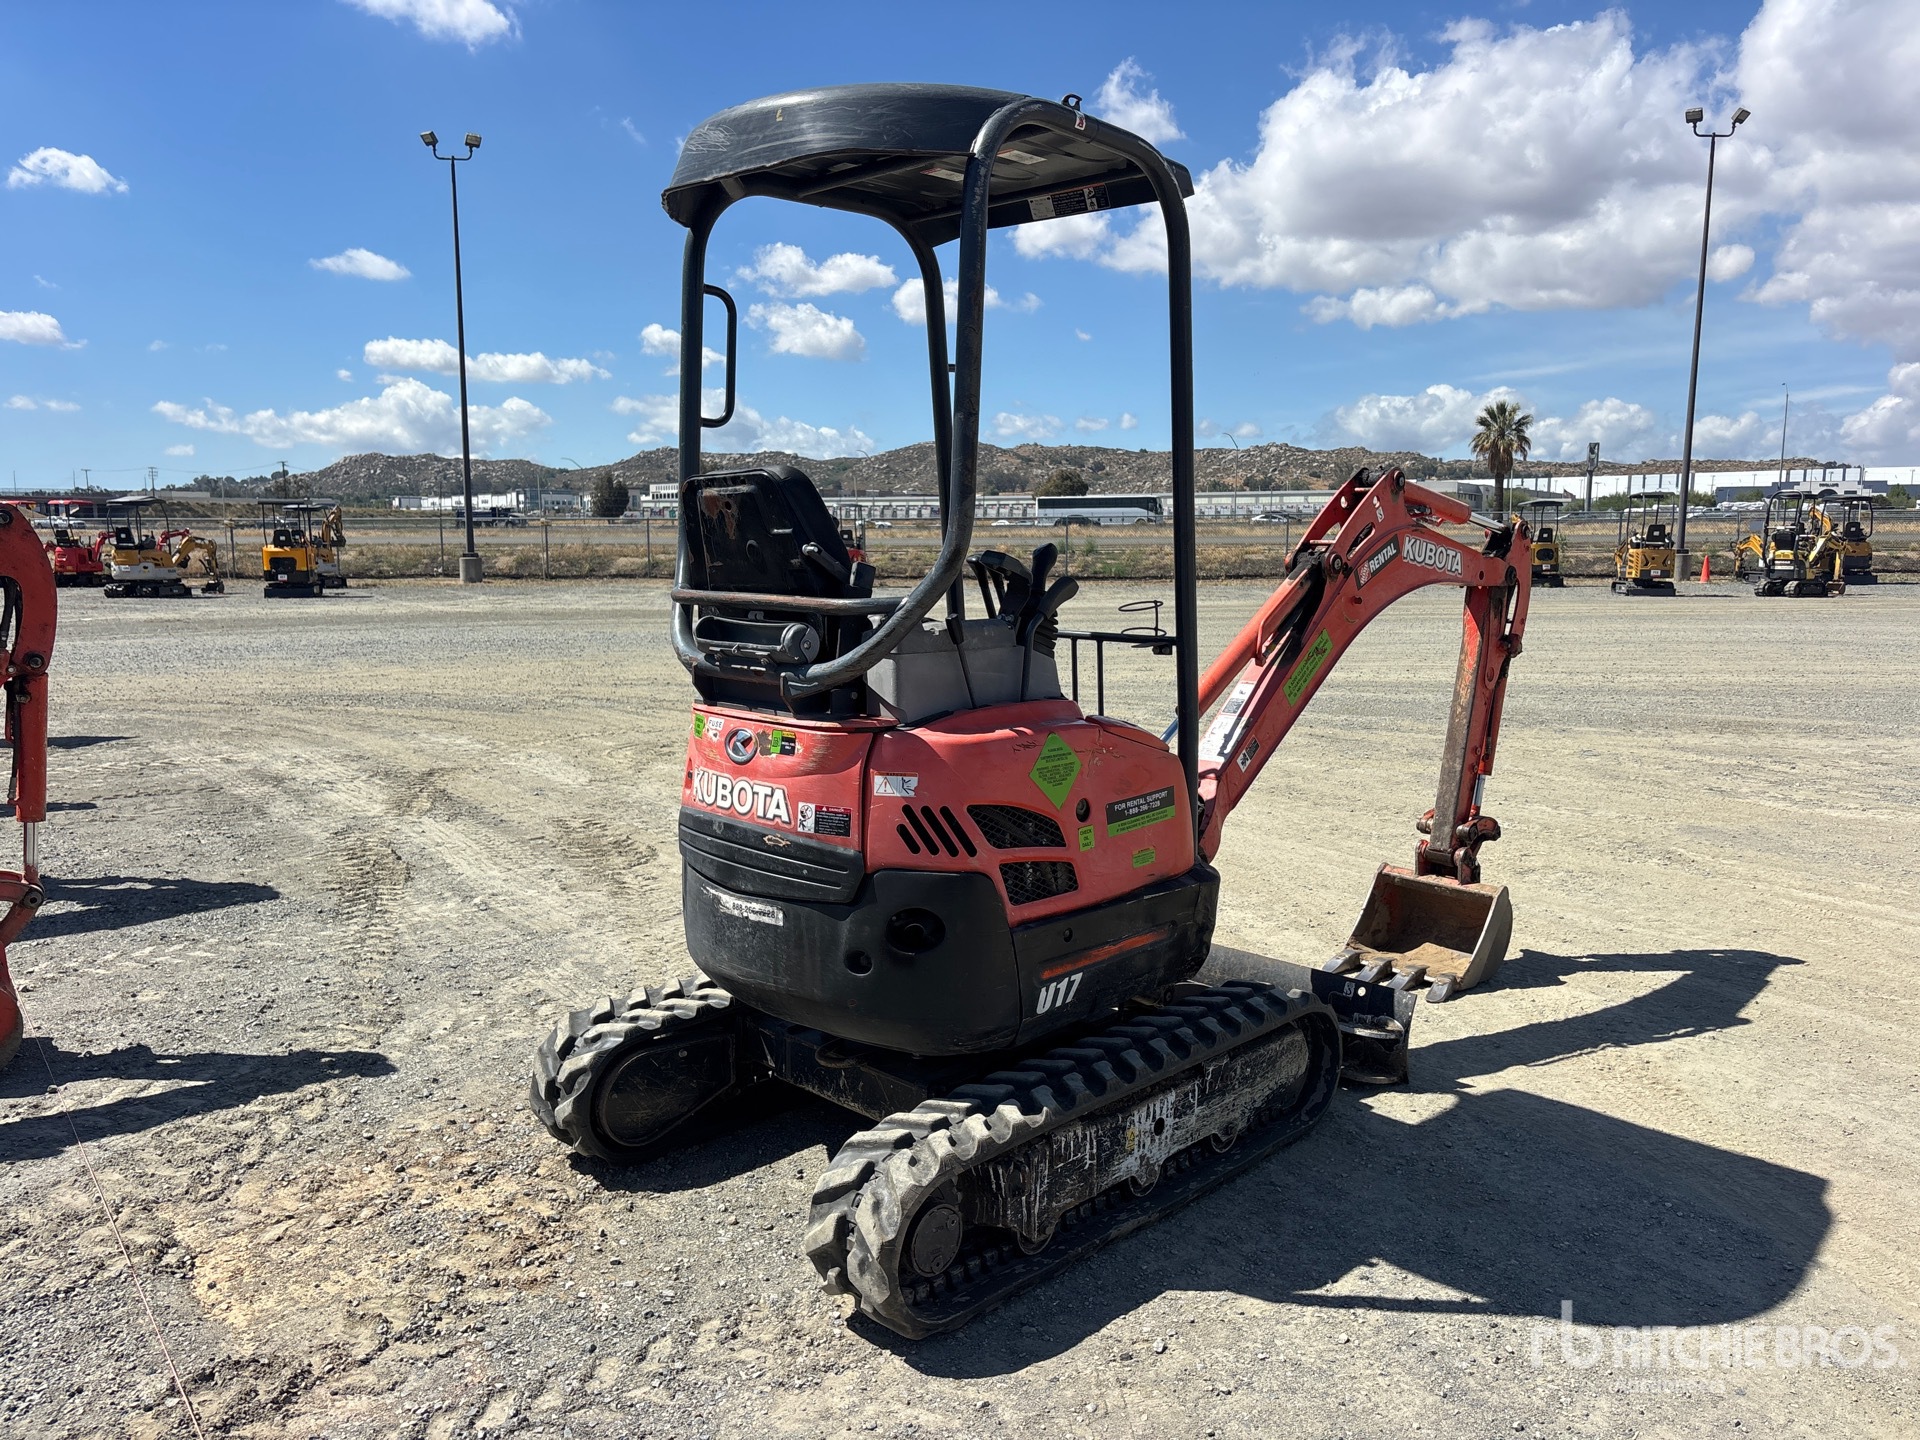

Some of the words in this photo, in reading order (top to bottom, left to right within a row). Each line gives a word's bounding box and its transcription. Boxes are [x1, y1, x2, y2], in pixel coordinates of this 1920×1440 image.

[1369, 543, 1397, 573] RENTAL
[1403, 536, 1462, 575] KUBOTA
[708, 719, 722, 728] FUSE
[693, 770, 790, 823] KUBOTA
[1114, 802, 1126, 811] FOR
[1127, 798, 1146, 808] RENTAL
[1147, 791, 1168, 803] SUPPORT
[1036, 972, 1083, 1015] U17
